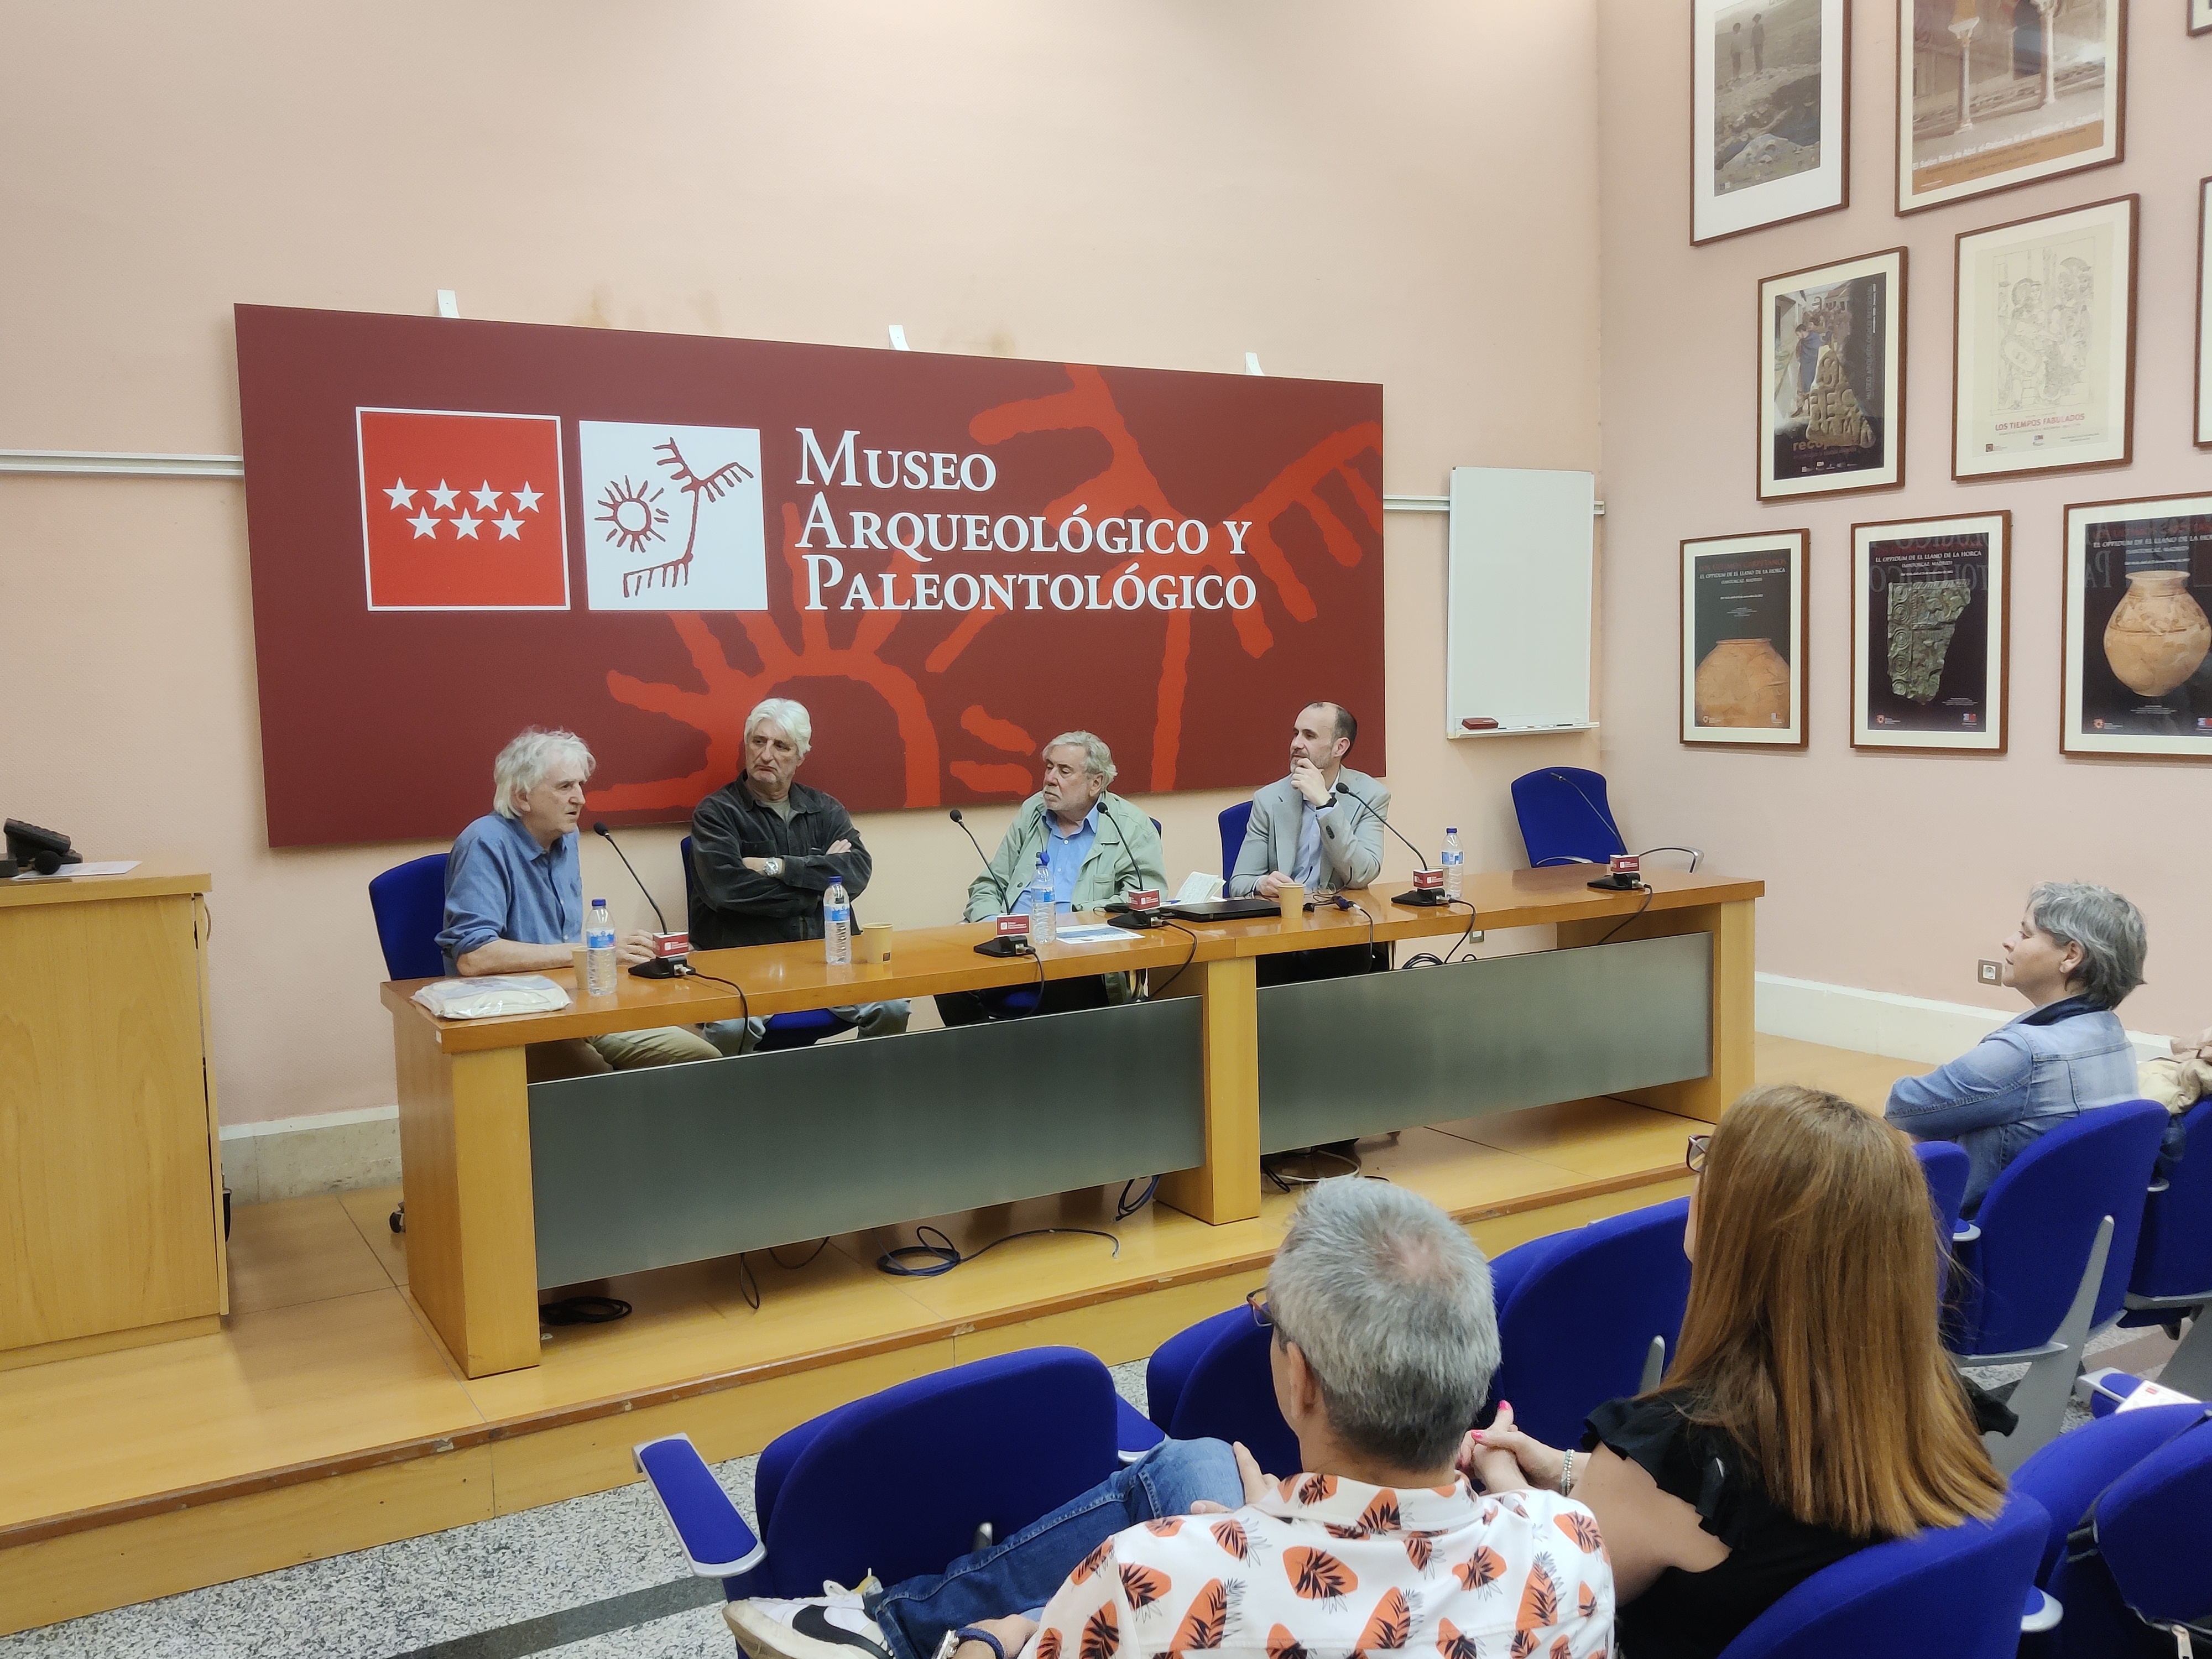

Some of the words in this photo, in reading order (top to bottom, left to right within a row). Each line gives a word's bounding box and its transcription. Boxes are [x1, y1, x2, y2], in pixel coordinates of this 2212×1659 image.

[1995, 422, 2008, 431] LOS
[2010, 419, 2041, 429] TIEMPOS
[2043, 413, 2086, 425] FABULADOS
[795, 427, 997, 491] MUSEO
[795, 491, 1209, 562] ARQUEOLÓGICO
[1223, 521, 1253, 554] Y
[801, 554, 1257, 611] PALEONTOLÓGICO
